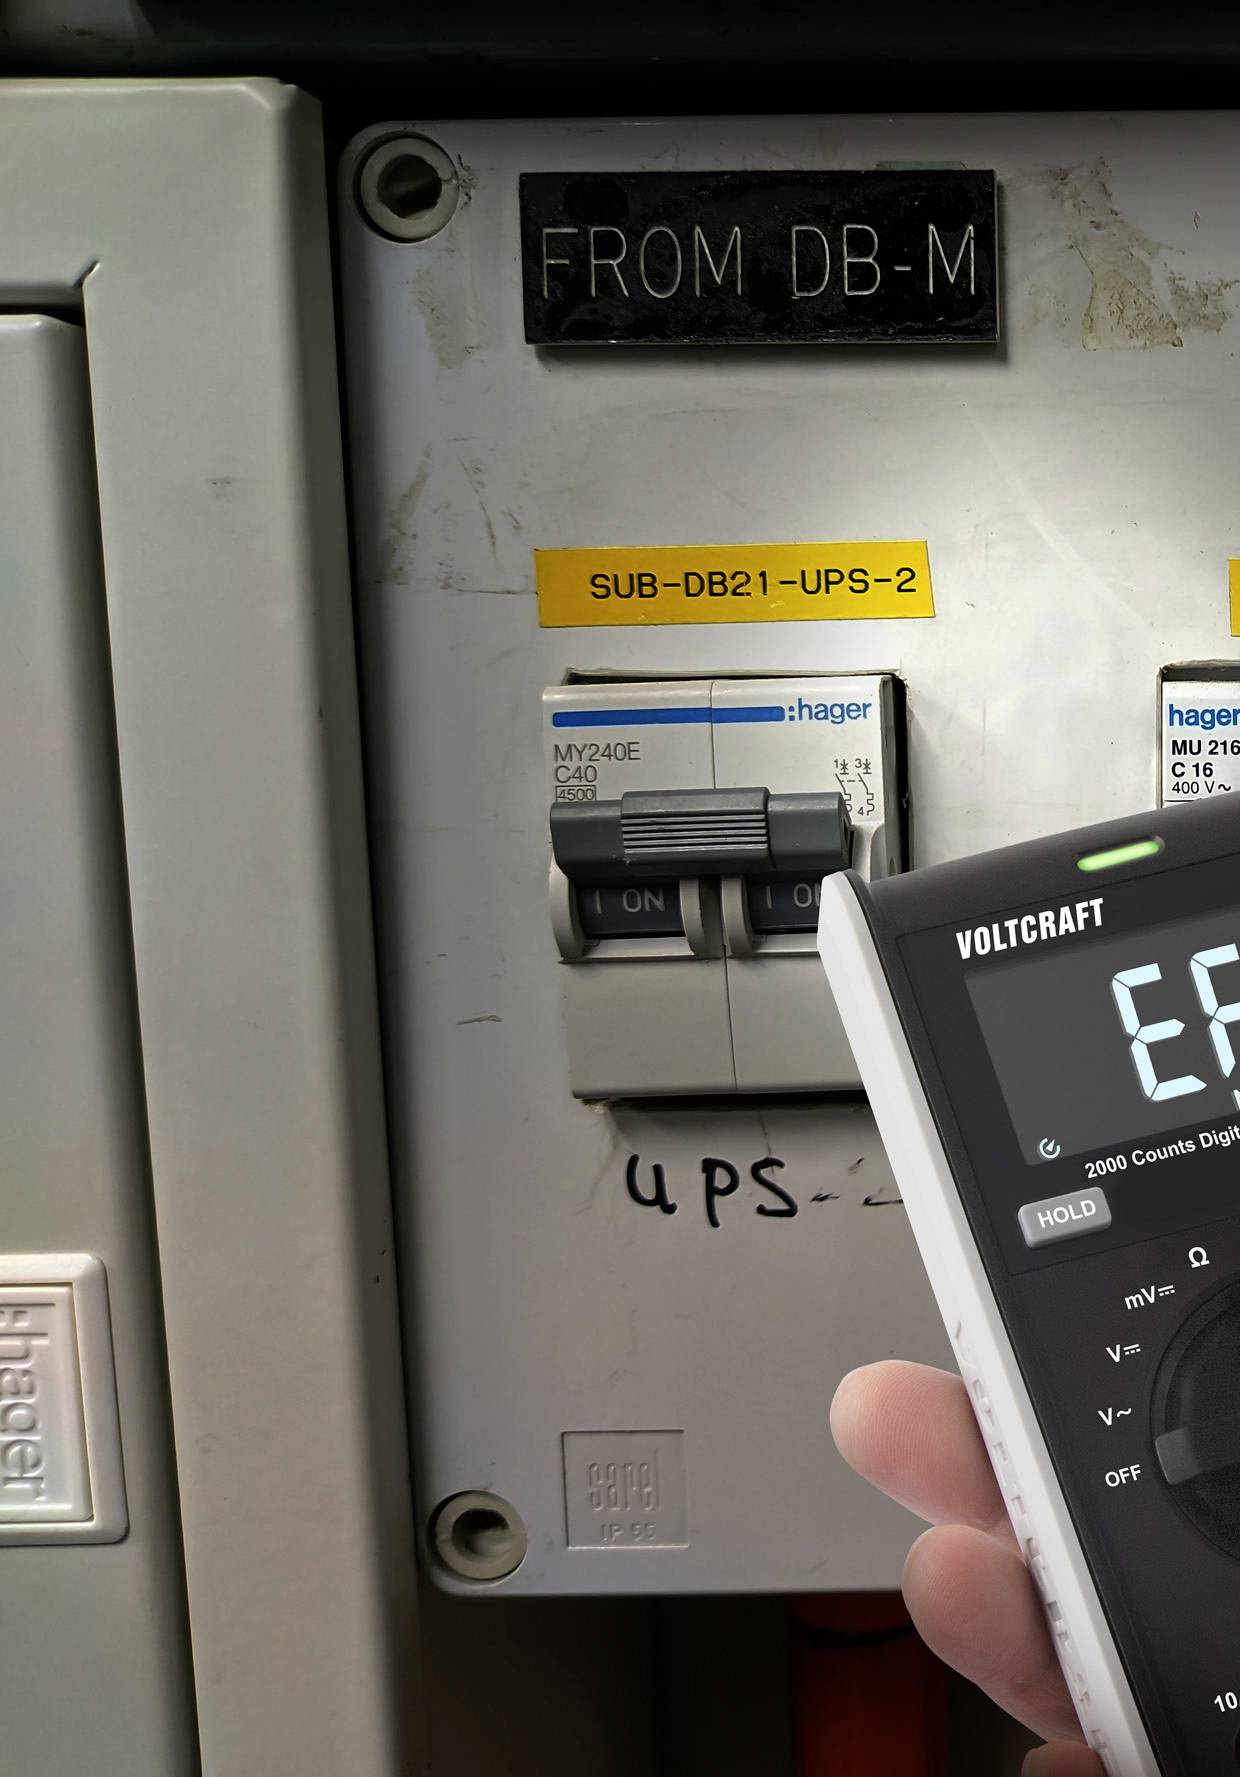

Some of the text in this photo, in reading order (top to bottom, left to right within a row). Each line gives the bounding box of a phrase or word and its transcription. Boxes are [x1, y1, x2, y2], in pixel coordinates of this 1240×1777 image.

[541, 223, 976, 299] FROM DB-M
[589, 566, 918, 599] SUB-DB21-UPS-2
[553, 742, 642, 763] MY240E
[1171, 740, 1202, 755] MU
[555, 765, 598, 783] C40
[1171, 763, 1214, 777] C 16
[558, 787, 595, 800] 4500
[1172, 781, 1199, 794] 400
[623, 889, 666, 913] ON
[793, 884, 821, 907] O
[956, 897, 1104, 960] VOLTCRAFT
[1084, 1154, 1128, 1180] 2000
[1131, 1138, 1196, 1167] Counts
[1037, 1199, 1097, 1229] HOLD
[1104, 1464, 1142, 1488] OFF
